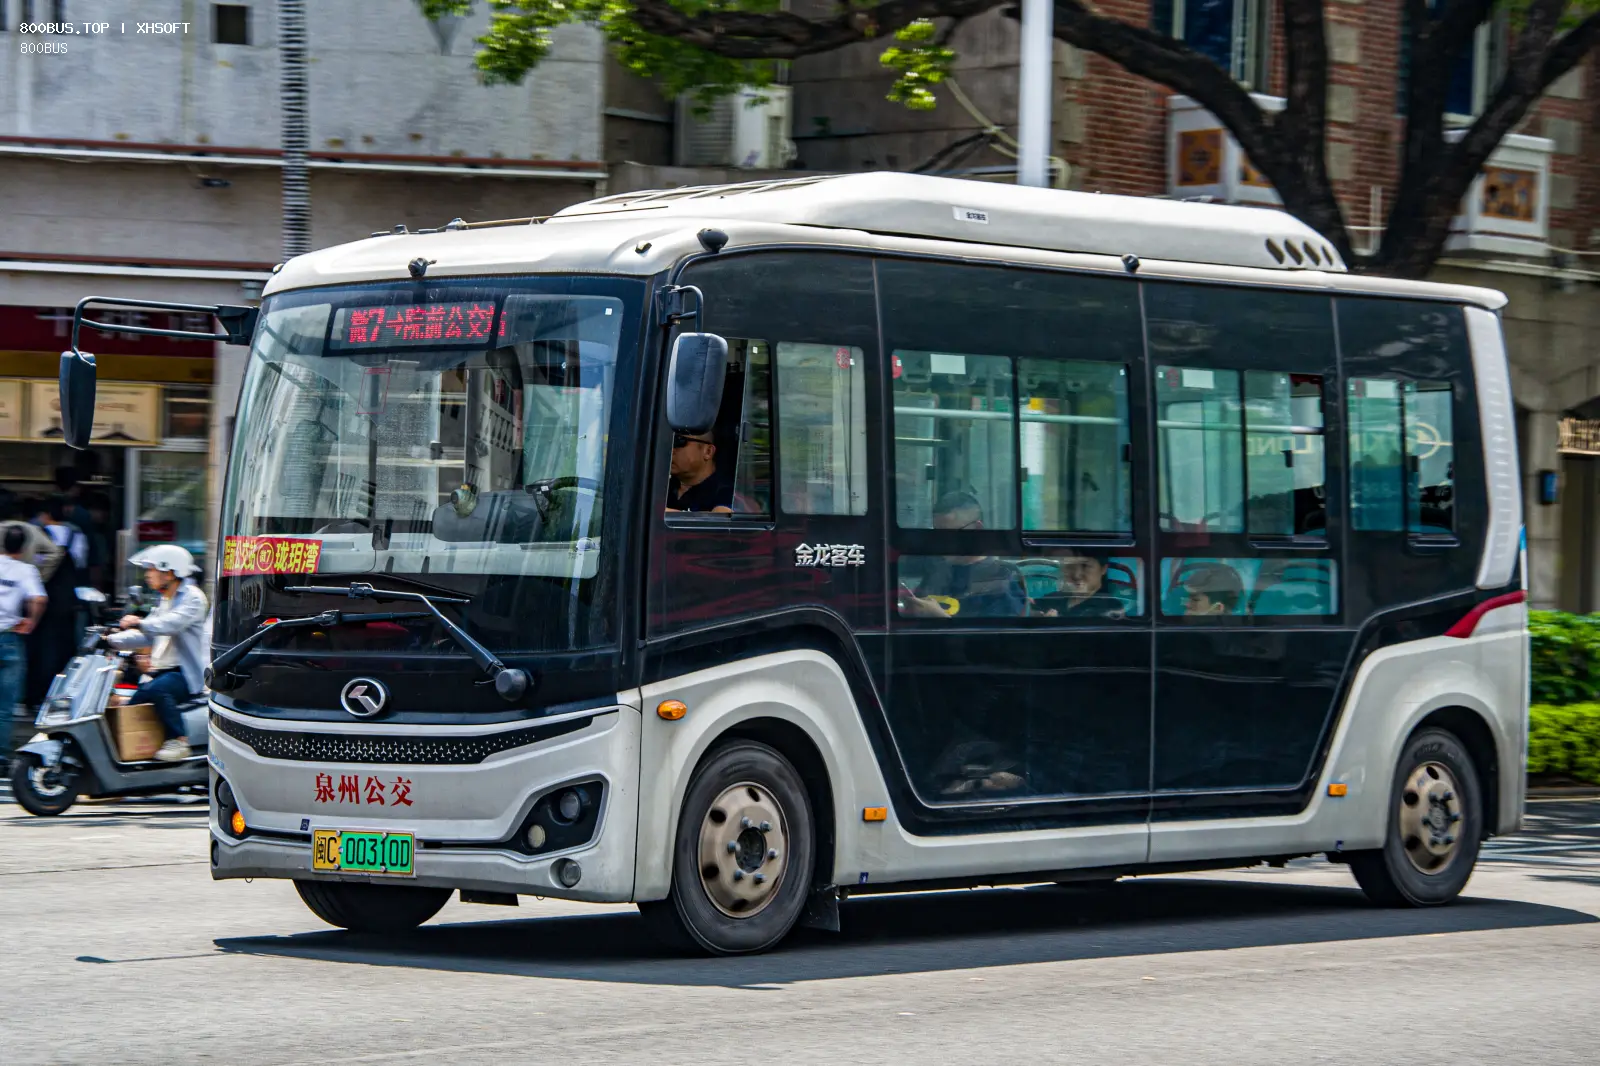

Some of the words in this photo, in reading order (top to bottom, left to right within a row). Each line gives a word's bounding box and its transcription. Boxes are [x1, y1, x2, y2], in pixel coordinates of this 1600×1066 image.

[274, 541, 319, 574] 珑玥湾
[795, 543, 866, 567] 金龙客车
[313, 772, 414, 807] 泉州公交
